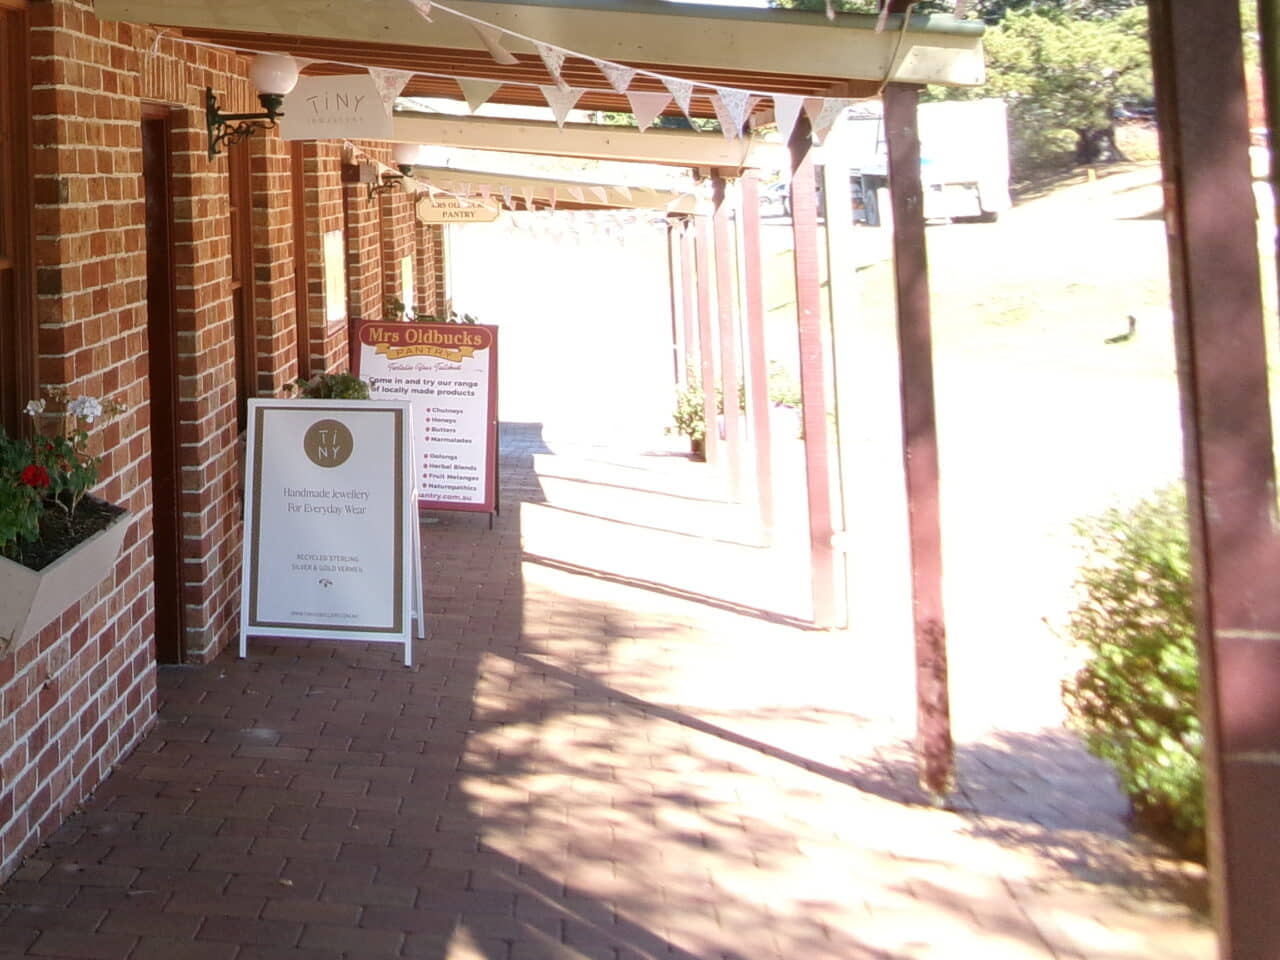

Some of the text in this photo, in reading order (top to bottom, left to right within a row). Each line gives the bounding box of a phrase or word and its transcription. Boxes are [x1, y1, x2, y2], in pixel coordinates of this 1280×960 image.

[369, 327, 482, 346] Mrs Oldbucks
[396, 346, 450, 358] PANTRY
[369, 377, 393, 385] Come
[395, 377, 403, 385] in
[423, 379, 435, 388] try
[382, 386, 408, 395] locally
[411, 387, 435, 395] made
[437, 388, 475, 397] products
[283, 487, 370, 501] Handmade Jewellery
[418, 492, 473, 501] antry.com.au
[287, 502, 368, 516] For Everyday Wear
